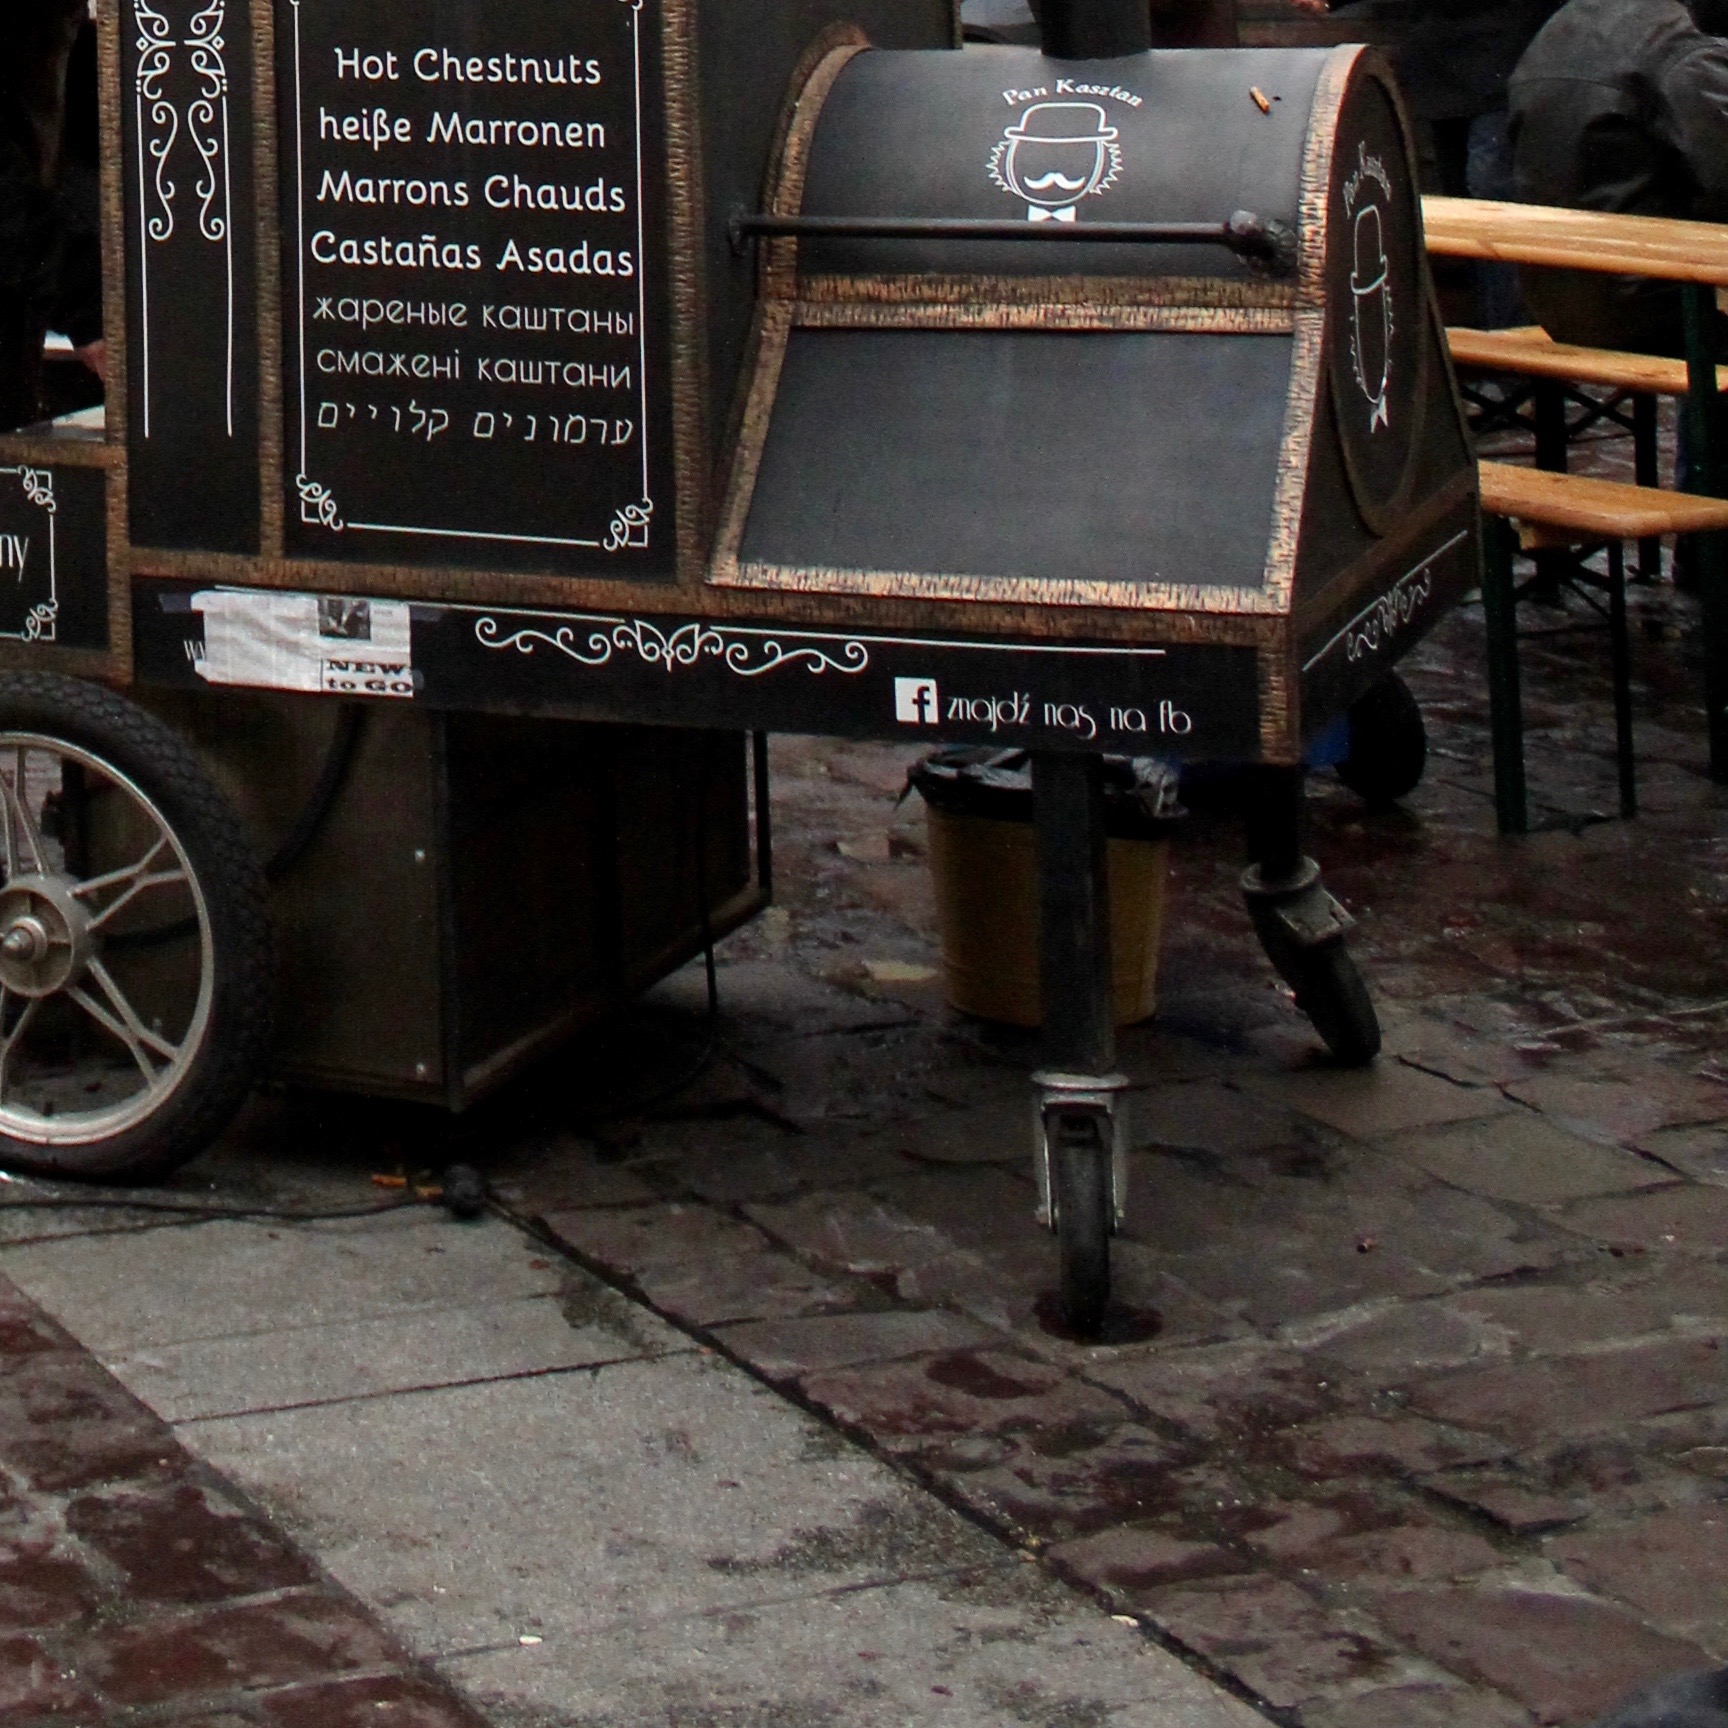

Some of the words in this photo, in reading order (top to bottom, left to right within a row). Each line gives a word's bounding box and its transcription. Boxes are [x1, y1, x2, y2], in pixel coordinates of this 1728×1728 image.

[334, 47, 399, 80] Hot
[413, 47, 602, 85] Chestnuts
[1002, 86, 1048, 107] Pan
[1056, 78, 1144, 108] Kasztan
[319, 106, 412, 152] heiße
[426, 111, 605, 148] Marronen
[316, 169, 470, 207] Marrons
[484, 174, 626, 213] Chauds
[310, 230, 482, 270] Castañas
[495, 238, 634, 277] Asadas
[312, 297, 468, 331] жареные
[482, 304, 634, 335] каштаны
[316, 348, 460, 379] смажені
[478, 357, 631, 389] каштани
[317, 399, 449, 442] קלויים
[473, 411, 634, 445] ערמונים
[327, 677, 356, 690] to
[364, 679, 414, 693] GO
[946, 690, 1031, 733] znajdź
[1044, 702, 1096, 740] nas
[1110, 706, 1147, 732] na
[1159, 699, 1192, 735] fb
